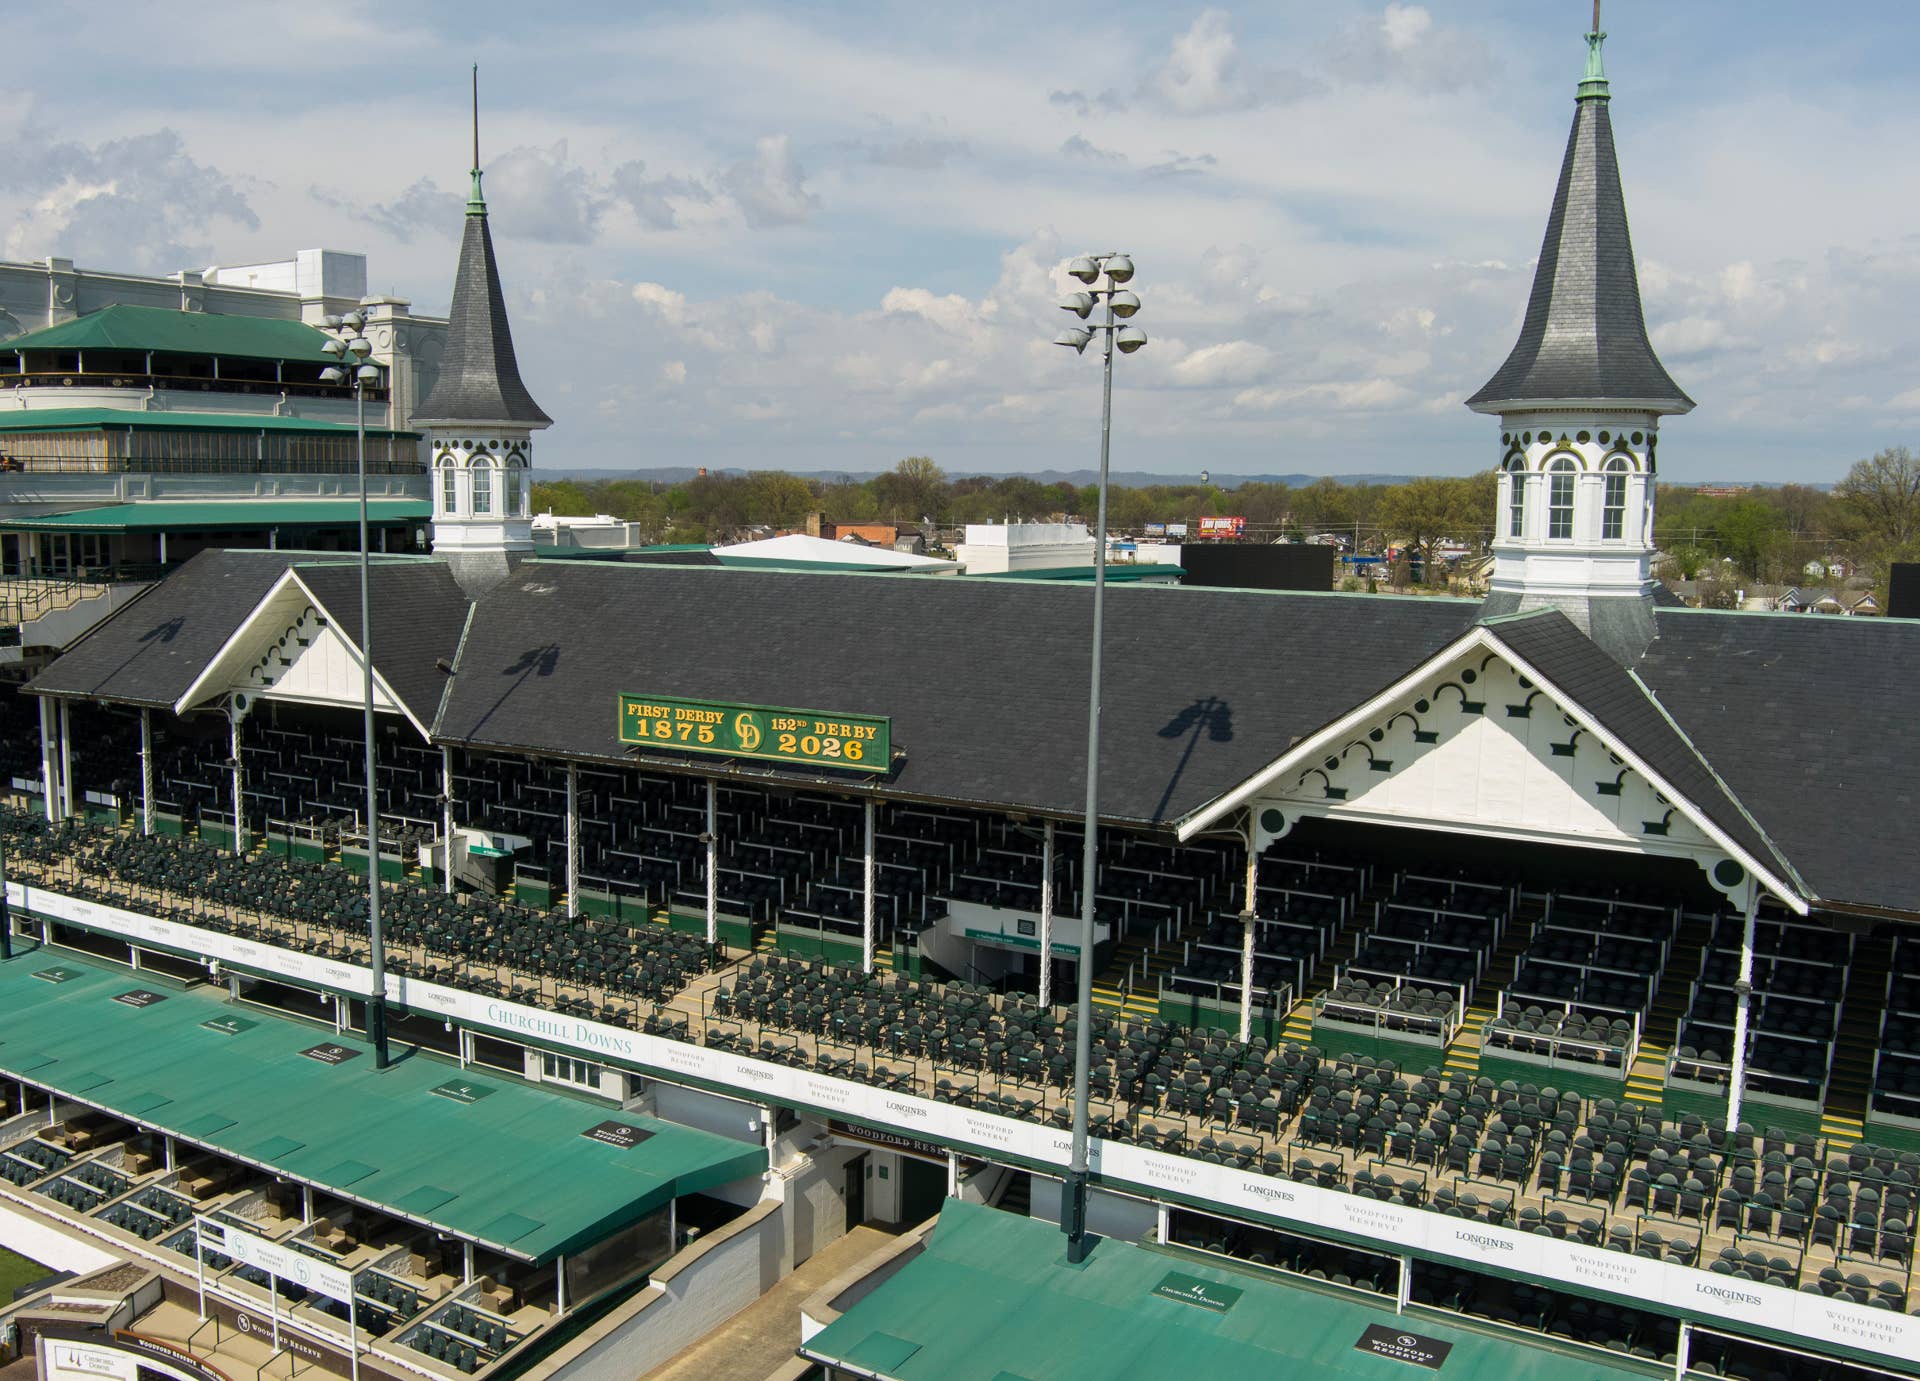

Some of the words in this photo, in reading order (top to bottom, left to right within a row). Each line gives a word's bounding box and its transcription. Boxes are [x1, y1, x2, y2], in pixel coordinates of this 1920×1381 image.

[627, 704, 670, 719] FIRST
[675, 708, 724, 724] DERBY
[637, 719, 715, 743] 1875
[815, 722, 876, 740] DERBY
[778, 734, 863, 760] 2026
[488, 1004, 570, 1039] CHURCHILL
[576, 1024, 632, 1055] DOWNS
[737, 1065, 774, 1081] LONGINES
[886, 1101, 927, 1117] LONGINES
[966, 1118, 1014, 1134] WOODFORD
[970, 1127, 1009, 1142] RESERVE
[847, 1124, 910, 1146] WOODFORD
[914, 1141, 967, 1160] RESEE
[1053, 1140, 1100, 1158] LONES
[1144, 1159, 1197, 1177] WOODFORD
[1148, 1170, 1192, 1185] RESERVE
[1243, 1183, 1295, 1201] LONGINES
[1344, 1204, 1404, 1223] WOODFORD
[1349, 1216, 1398, 1232] RESERVE
[1456, 1231, 1514, 1250] LONGINES
[1570, 1254, 1637, 1274] WOODFORD
[1575, 1266, 1630, 1284] RESERVE
[1161, 1286, 1197, 1300] CHURCHILL
[1199, 1296, 1225, 1307] DOWNS
[1696, 1284, 1762, 1305] LONGINES
[1826, 1310, 1903, 1333] WOODFORD
[252, 1324, 288, 1344] WOODFRD
[1832, 1324, 1895, 1344] RESERVE
[1371, 1339, 1434, 1359] WOODFORD
[1373, 1345, 1426, 1362] RESERVE
